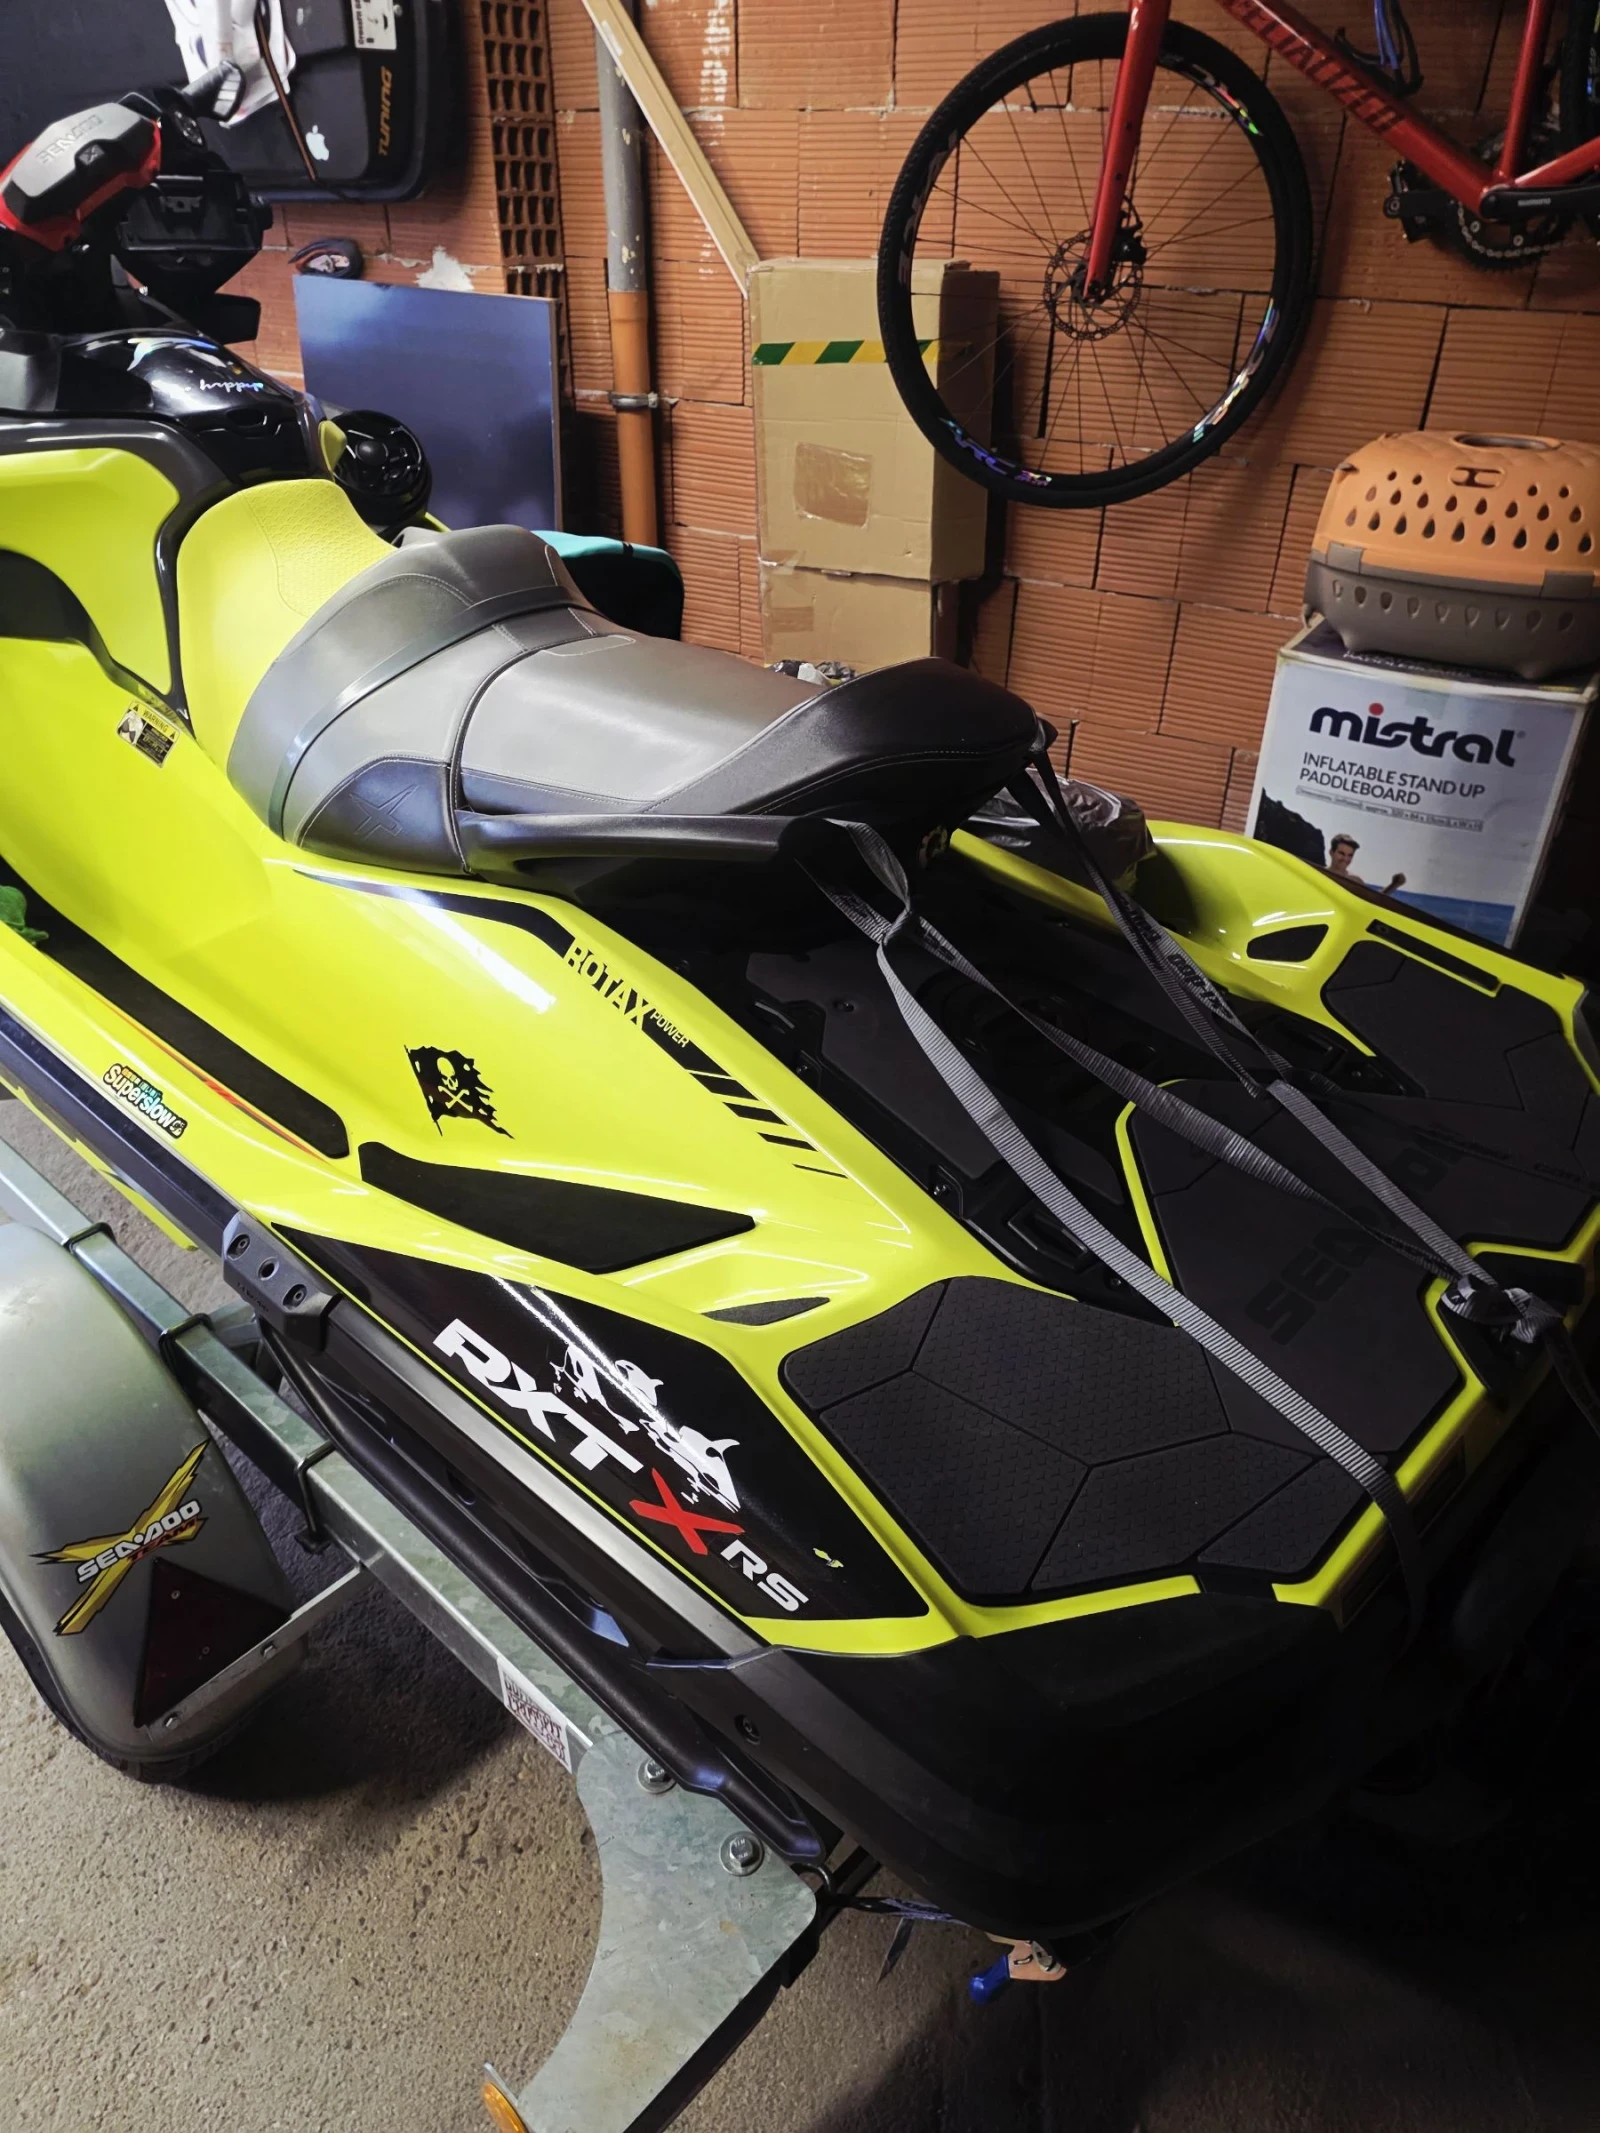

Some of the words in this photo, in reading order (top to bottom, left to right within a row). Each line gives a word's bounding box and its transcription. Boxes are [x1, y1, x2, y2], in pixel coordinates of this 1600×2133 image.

[143, 710, 169, 733] WARNING
[1309, 703, 1517, 767] mistral
[1300, 768, 1421, 806] PADDLEBOARD
[1303, 752, 1397, 785] INFLATABLE
[1397, 773, 1457, 796] STAND
[1459, 783, 1485, 799] UP
[563, 942, 652, 1029] ROTAX
[650, 1009, 689, 1048] POWER
[104, 1065, 177, 1128] Superslow
[433, 1319, 644, 1473] RXT
[629, 1468, 746, 1555] X
[721, 1540, 810, 1612] RS
